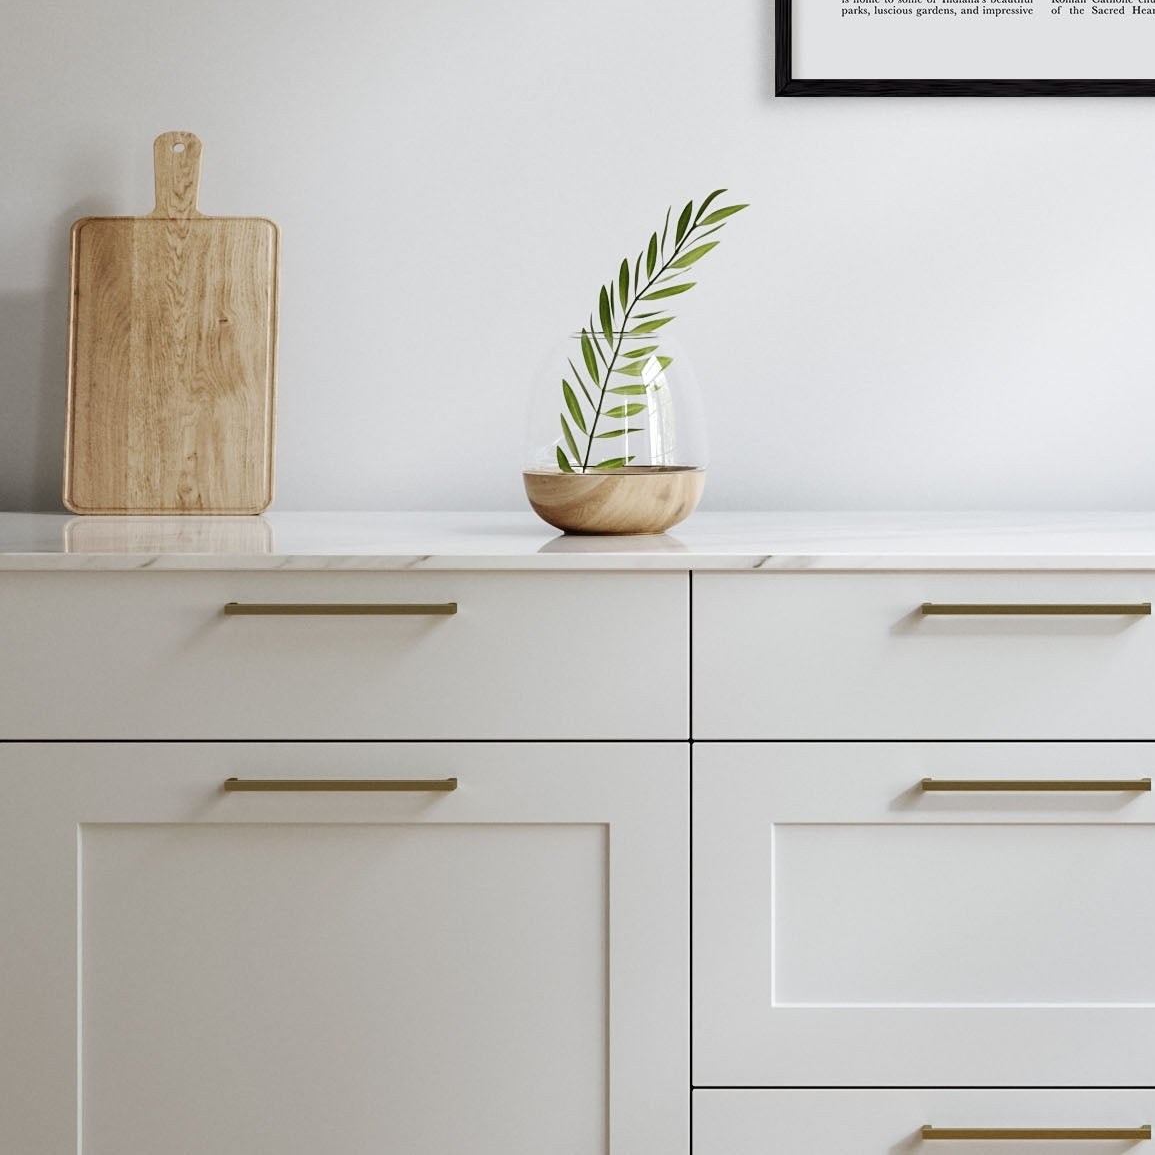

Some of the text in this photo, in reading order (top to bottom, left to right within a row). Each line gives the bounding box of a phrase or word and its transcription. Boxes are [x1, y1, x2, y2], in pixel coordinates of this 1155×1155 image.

[842, 6, 1033, 17] parks, luscious gardens, and impressive
